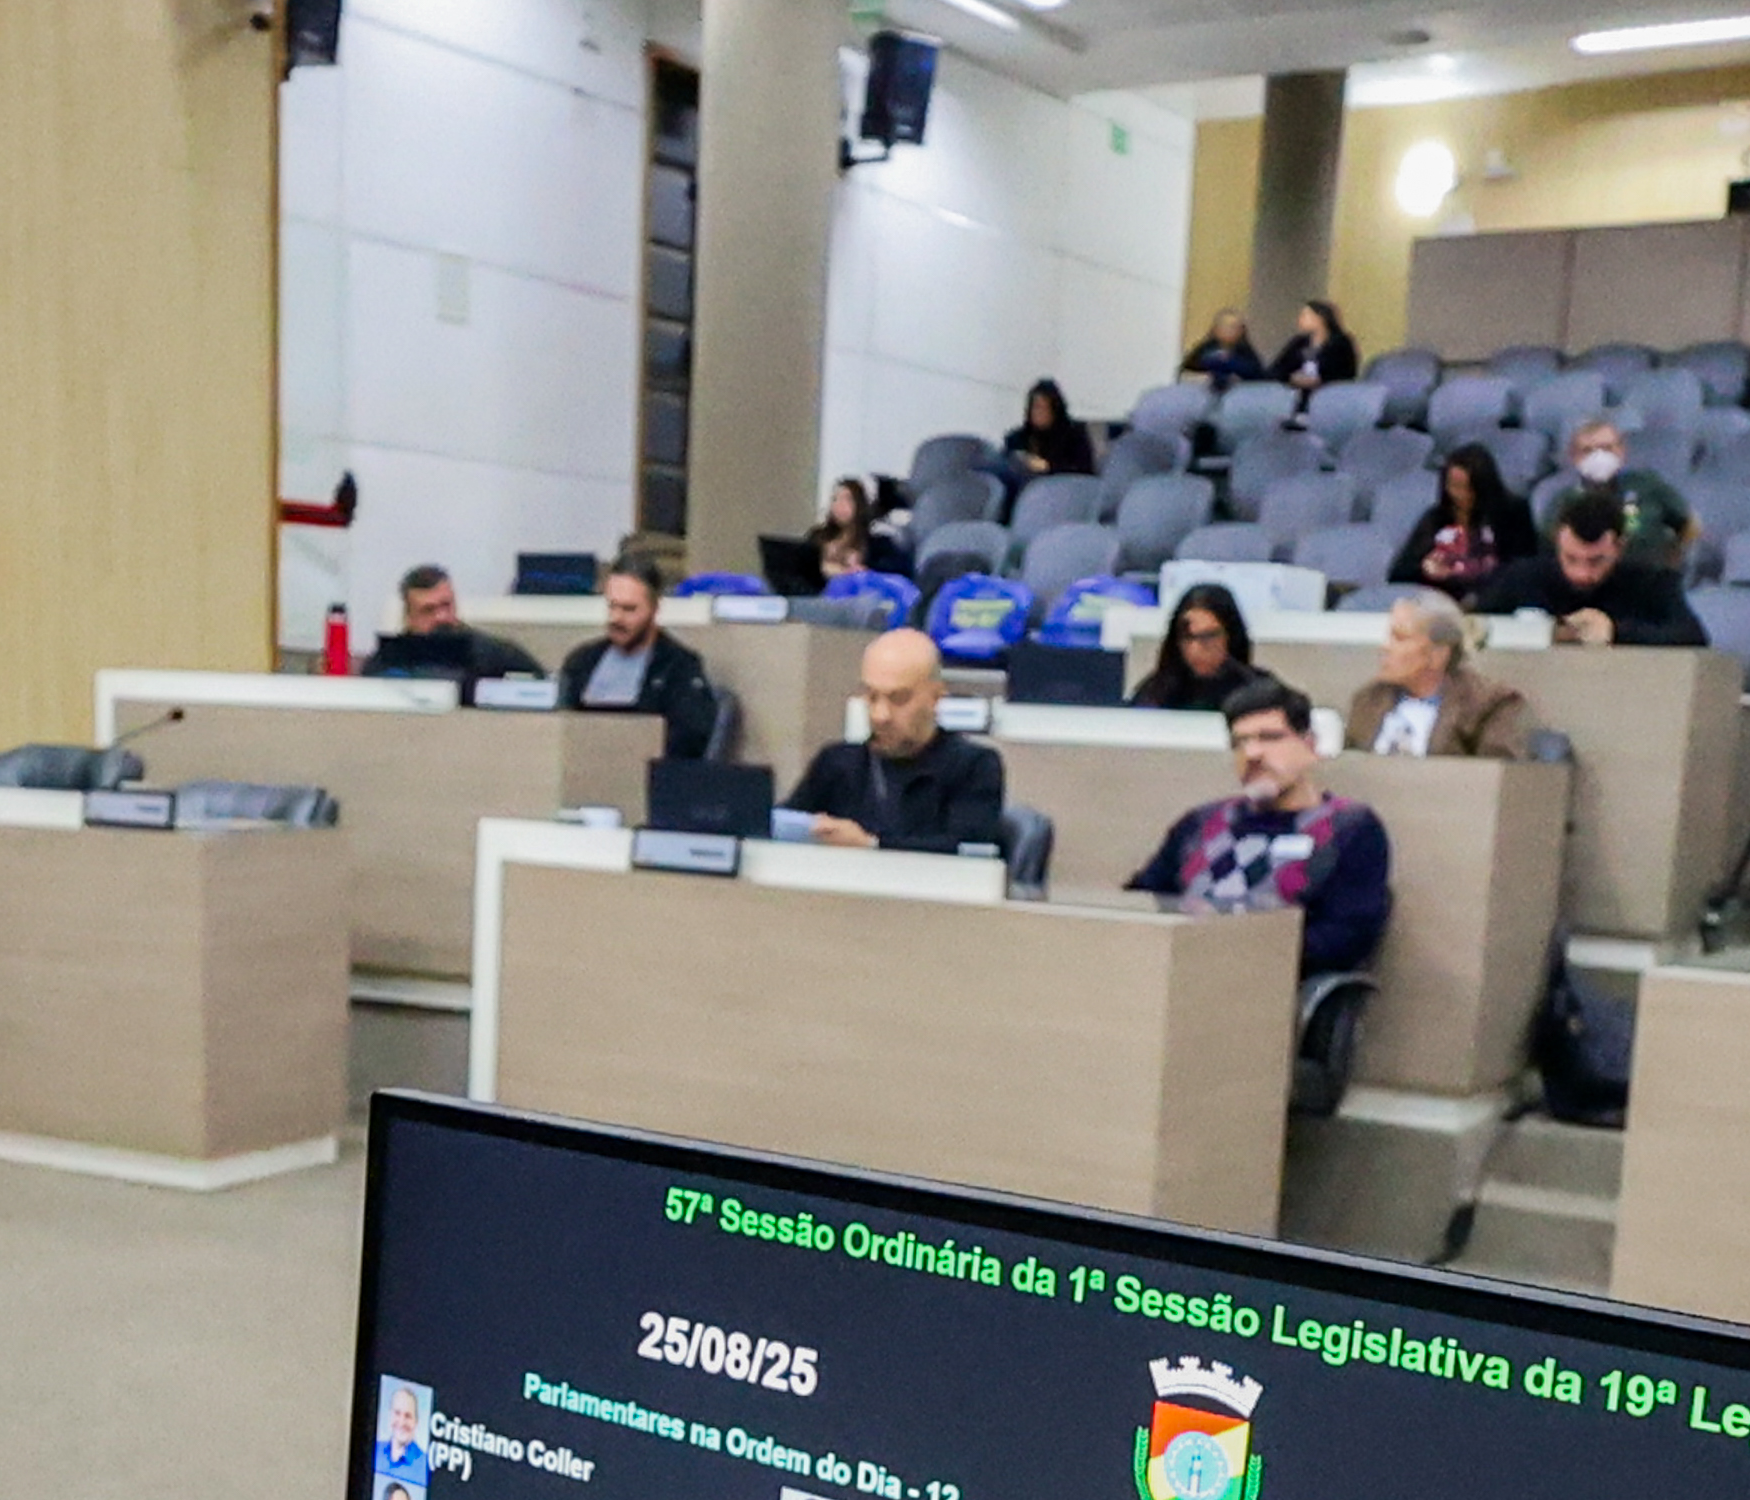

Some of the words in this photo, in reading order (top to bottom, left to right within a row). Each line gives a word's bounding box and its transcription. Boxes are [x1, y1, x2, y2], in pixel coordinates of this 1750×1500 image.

[666, 1187, 713, 1223] 57ª
[720, 1198, 834, 1250] Sessão
[844, 1223, 1001, 1285] Ordinária
[1012, 1257, 1055, 1297] da
[1069, 1267, 1105, 1302] 1ª
[1114, 1275, 1260, 1337] Sessão
[1272, 1305, 1509, 1389] Legislativa
[1524, 1358, 1581, 1404] da
[1600, 1370, 1676, 1416] 19ª
[638, 1312, 817, 1396] 25/08/25
[428, 1441, 472, 1481] (PP)
[430, 1411, 524, 1462] Cristiano
[526, 1439, 596, 1483] Coller
[524, 1373, 685, 1440] Parlamentares
[690, 1423, 721, 1451] na
[726, 1428, 811, 1475] Ordem
[816, 1453, 851, 1485] do
[857, 1461, 901, 1500] Dia
